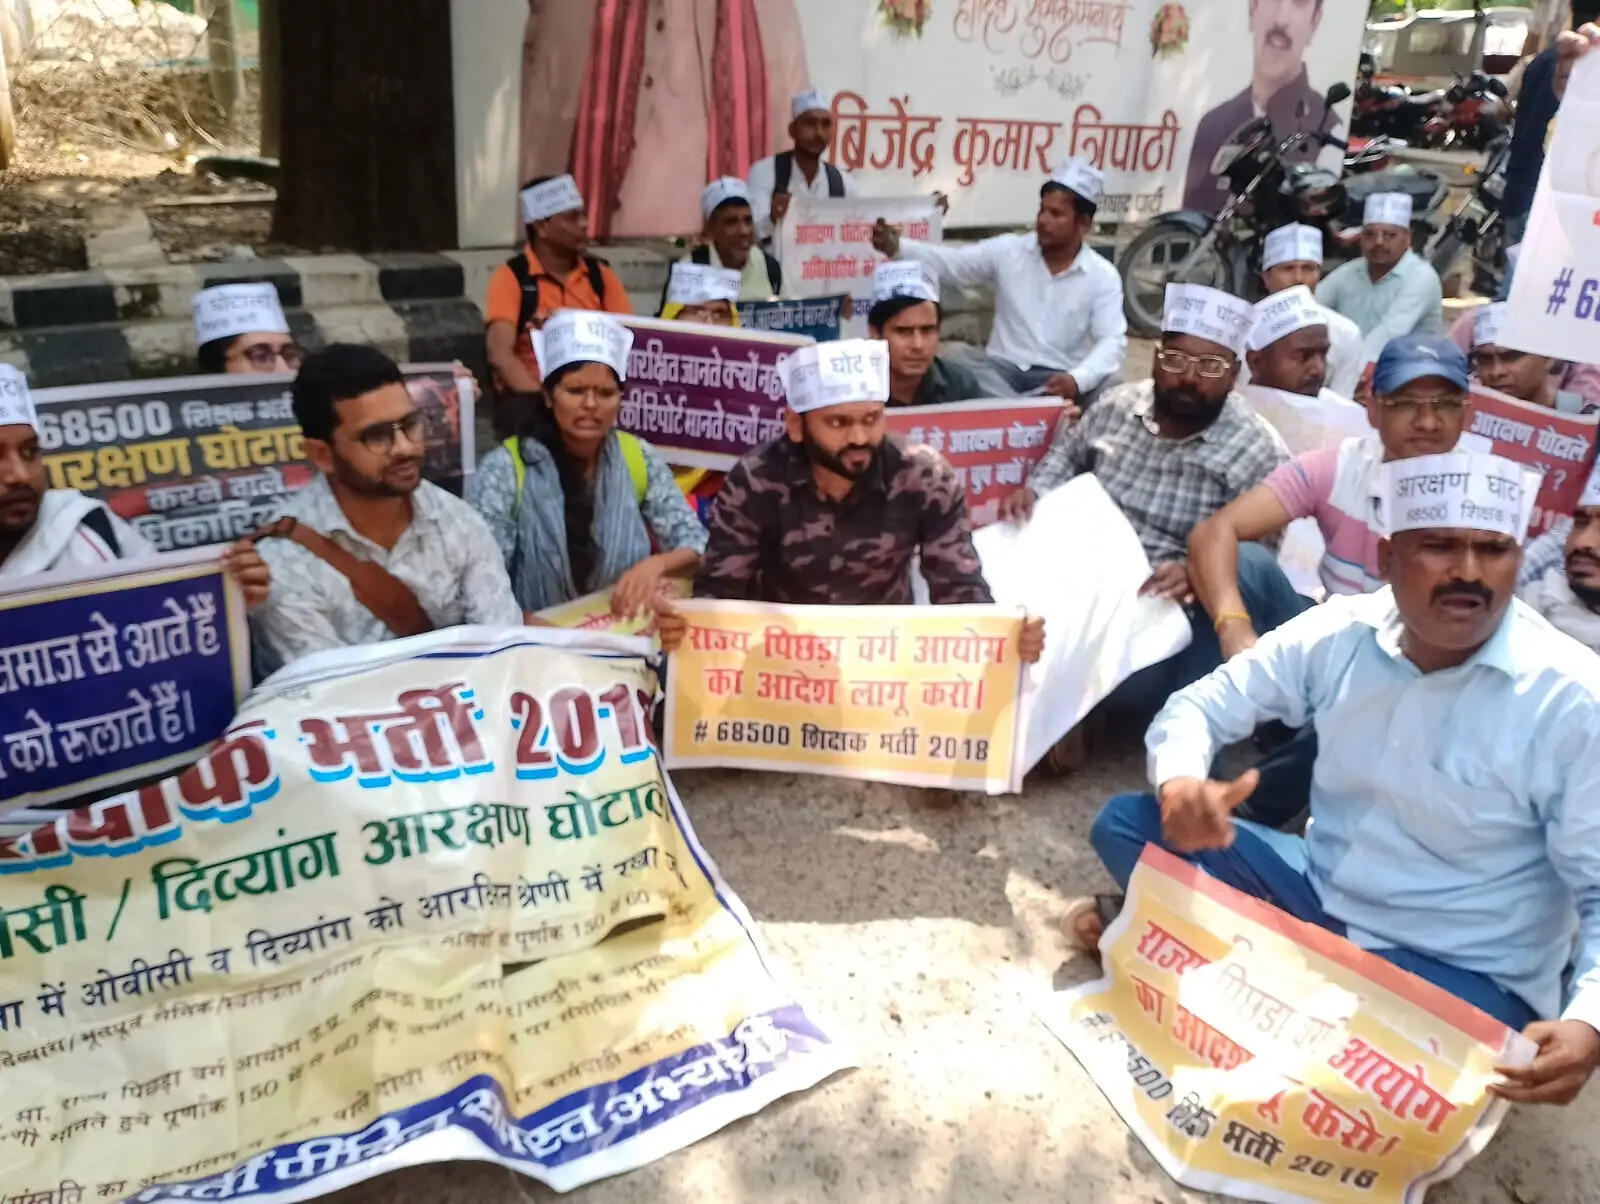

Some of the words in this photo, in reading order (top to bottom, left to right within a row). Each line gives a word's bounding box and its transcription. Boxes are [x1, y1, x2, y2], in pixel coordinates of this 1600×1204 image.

[953, 118, 1063, 186] कुमार
[1069, 104, 1181, 172] त्रिपाठी
[38, 401, 173, 451] 68500
[82, 610, 124, 676] से
[123, 597, 193, 669] आते
[187, 591, 221, 656] हैं
[685, 624, 753, 652] राज्य
[763, 624, 842, 669] पिछड़ा
[857, 627, 899, 663] वर्ग
[913, 627, 1007, 664] आयोग
[4, 708, 58, 773] को
[54, 688, 157, 765] रुलाते
[704, 667, 743, 696] का
[756, 668, 838, 707] आदेश
[850, 678, 911, 717] लागू
[297, 682, 495, 789] भर्ती
[717, 721, 790, 747] 68500
[801, 722, 869, 755] शिक्षक
[929, 734, 990, 761] 2018
[151, 827, 341, 921] दिव्यांग
[362, 803, 530, 867] आरक्षण
[37, 981, 66, 1018] में
[81, 947, 194, 1007] ओबीसी
[207, 948, 232, 974] व
[245, 909, 352, 967] दिव्यांग
[365, 895, 404, 933] को
[581, 863, 604, 894] में
[1129, 973, 1165, 1024] का
[1327, 1032, 1459, 1135] आयोग
